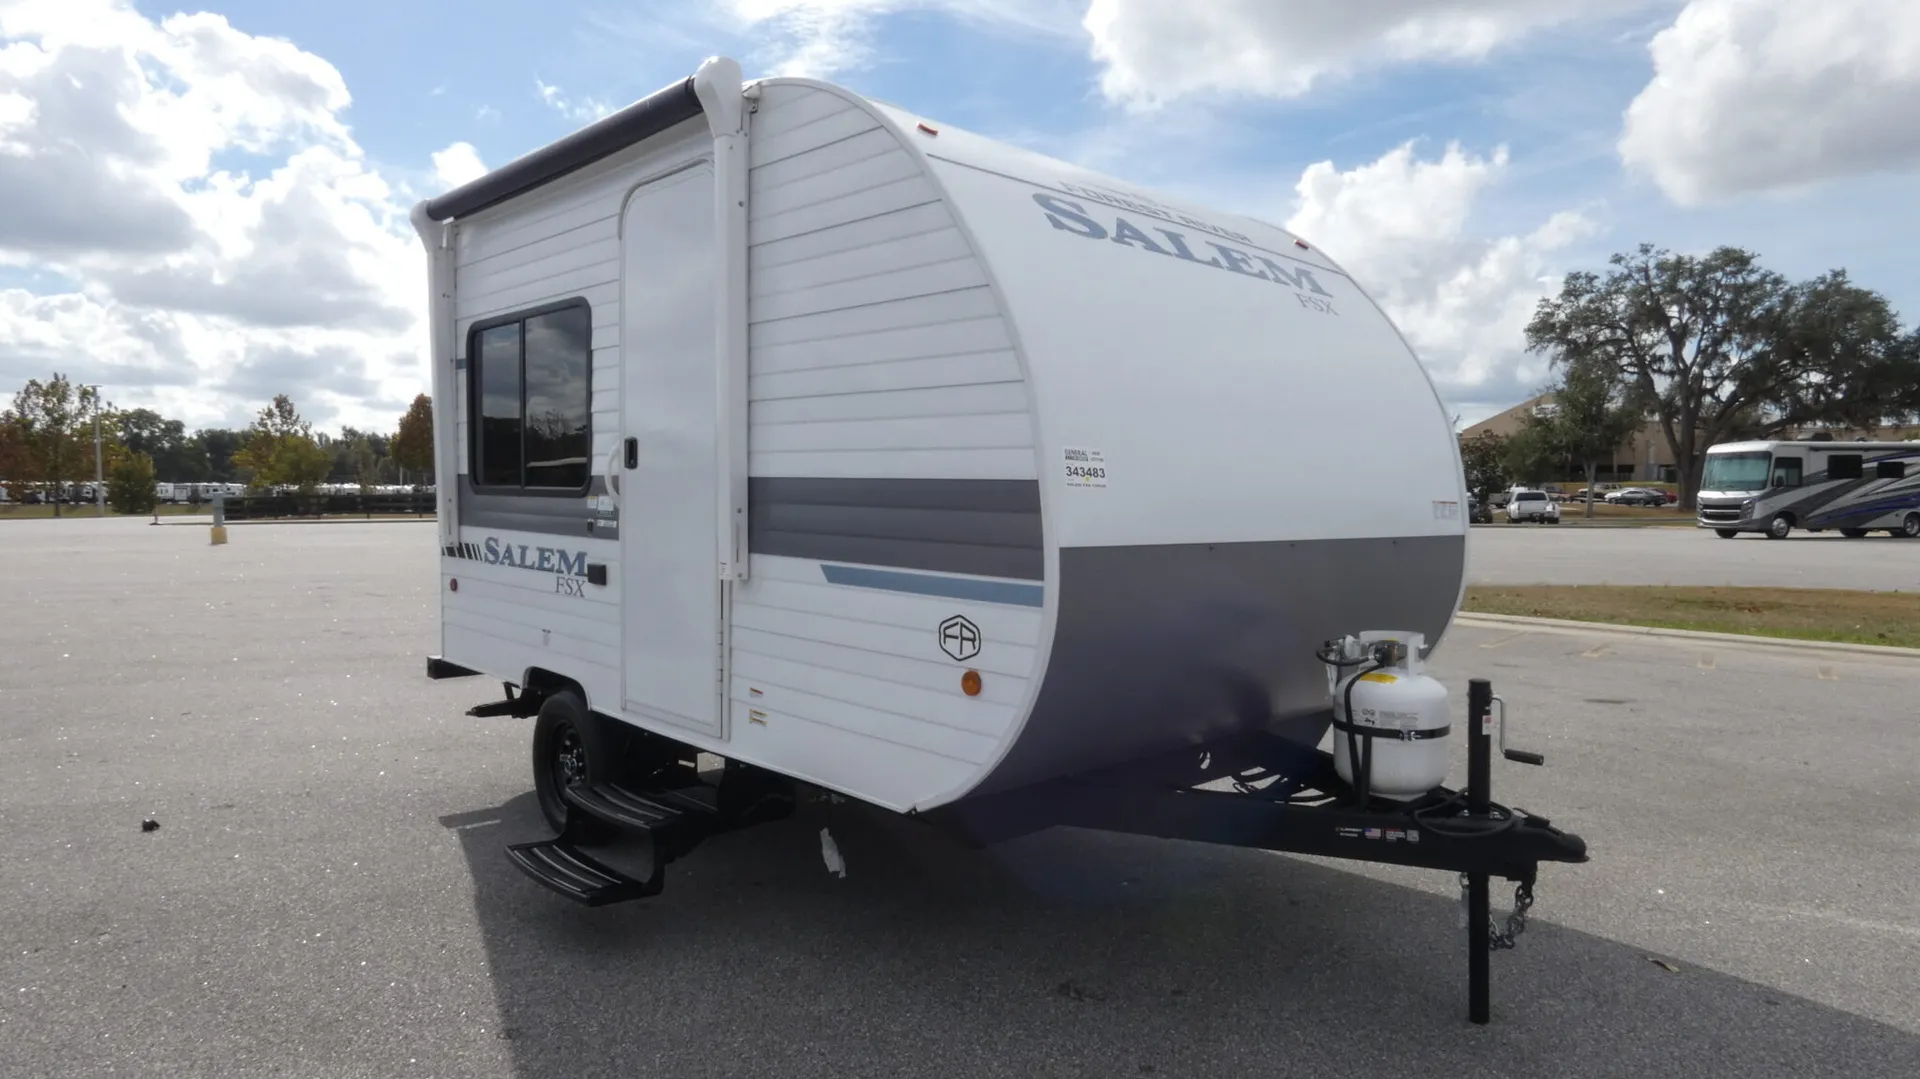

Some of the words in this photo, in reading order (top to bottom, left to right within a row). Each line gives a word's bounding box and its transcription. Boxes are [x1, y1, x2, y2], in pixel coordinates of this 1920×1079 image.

[1032, 193, 1333, 299] SALEM
[1294, 292, 1340, 316] FSX
[1066, 466, 1105, 478] 343483
[484, 536, 588, 577] SALEM
[555, 576, 586, 598] FSX
